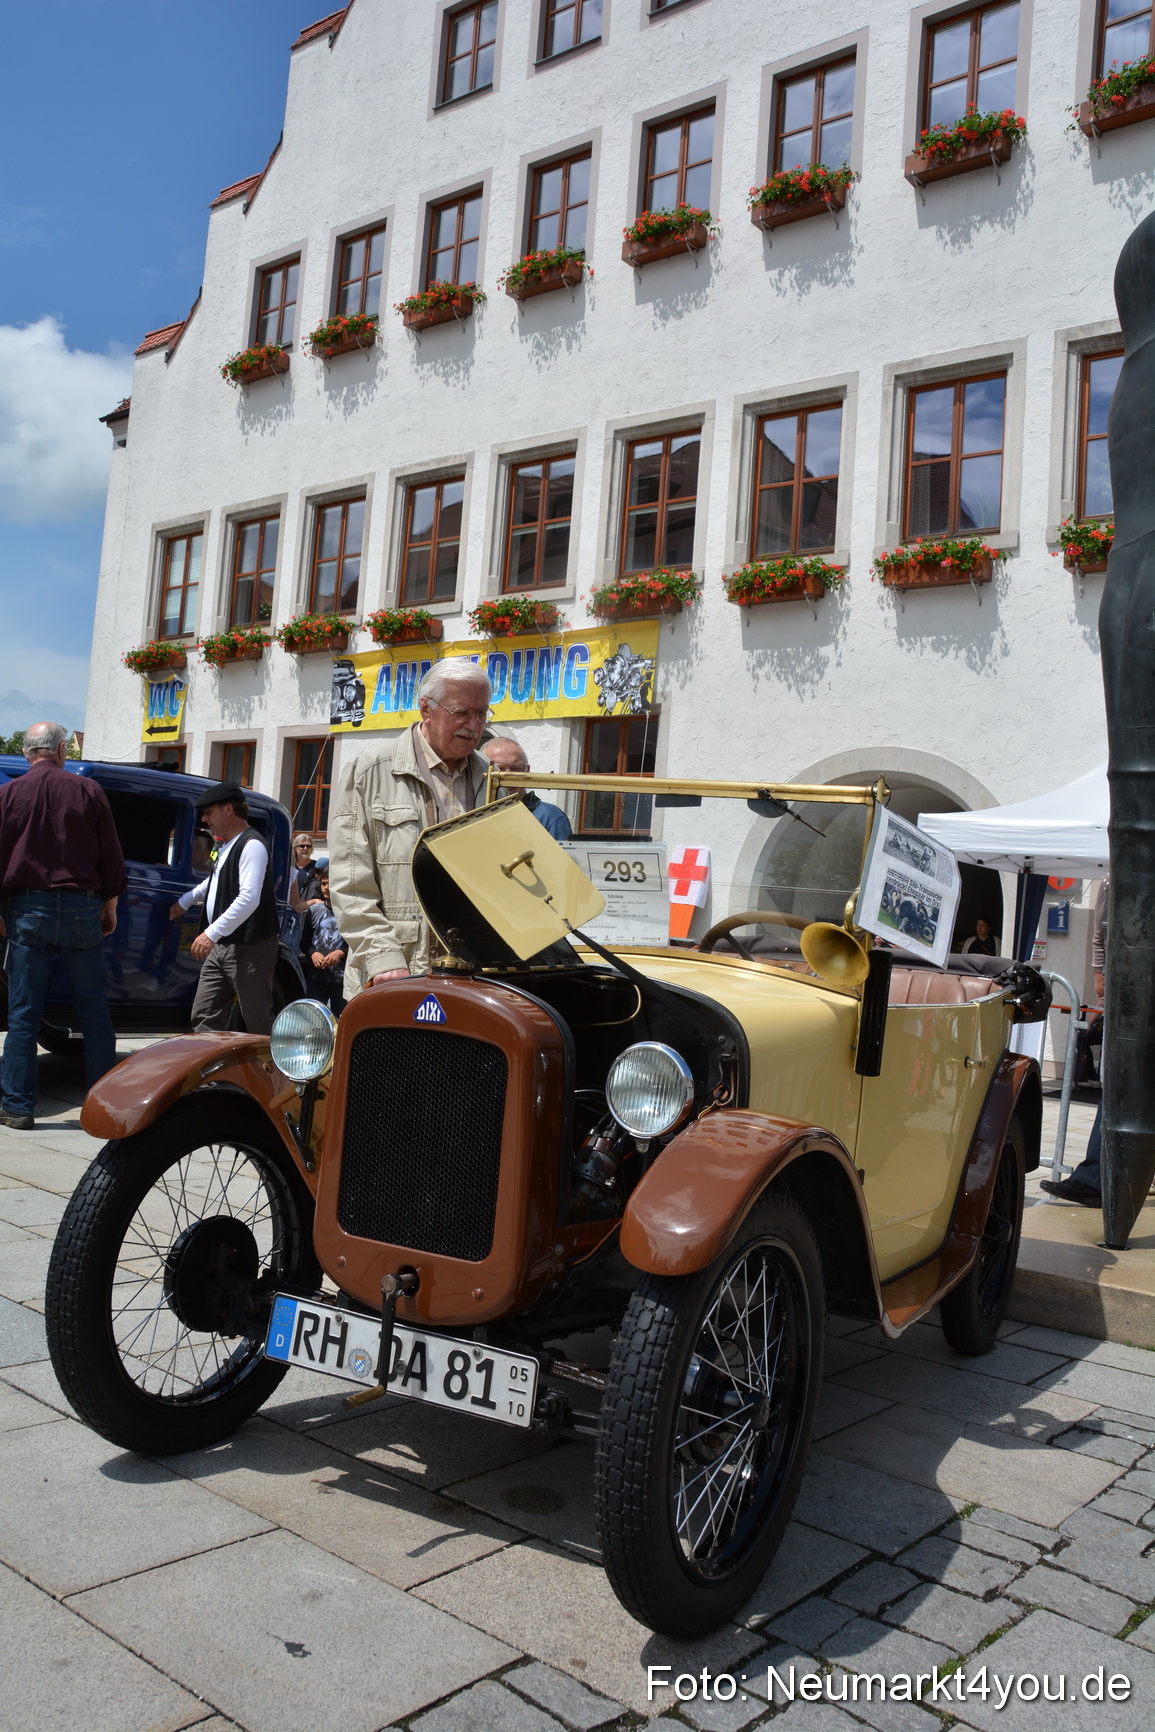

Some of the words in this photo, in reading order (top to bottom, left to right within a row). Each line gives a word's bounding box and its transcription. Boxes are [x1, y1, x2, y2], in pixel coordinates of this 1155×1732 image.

[370, 642, 592, 715] ANDUNG
[147, 680, 185, 719] WC
[603, 861, 647, 883] 293
[907, 885, 926, 901] Ehepaar
[416, 1001, 441, 1022] DIXI
[275, 1333, 284, 1348] D
[292, 1310, 349, 1369] RH
[373, 1331, 428, 1392] DA
[443, 1350, 497, 1410] 81
[509, 1365, 528, 1382] 05
[508, 1400, 525, 1418] 10
